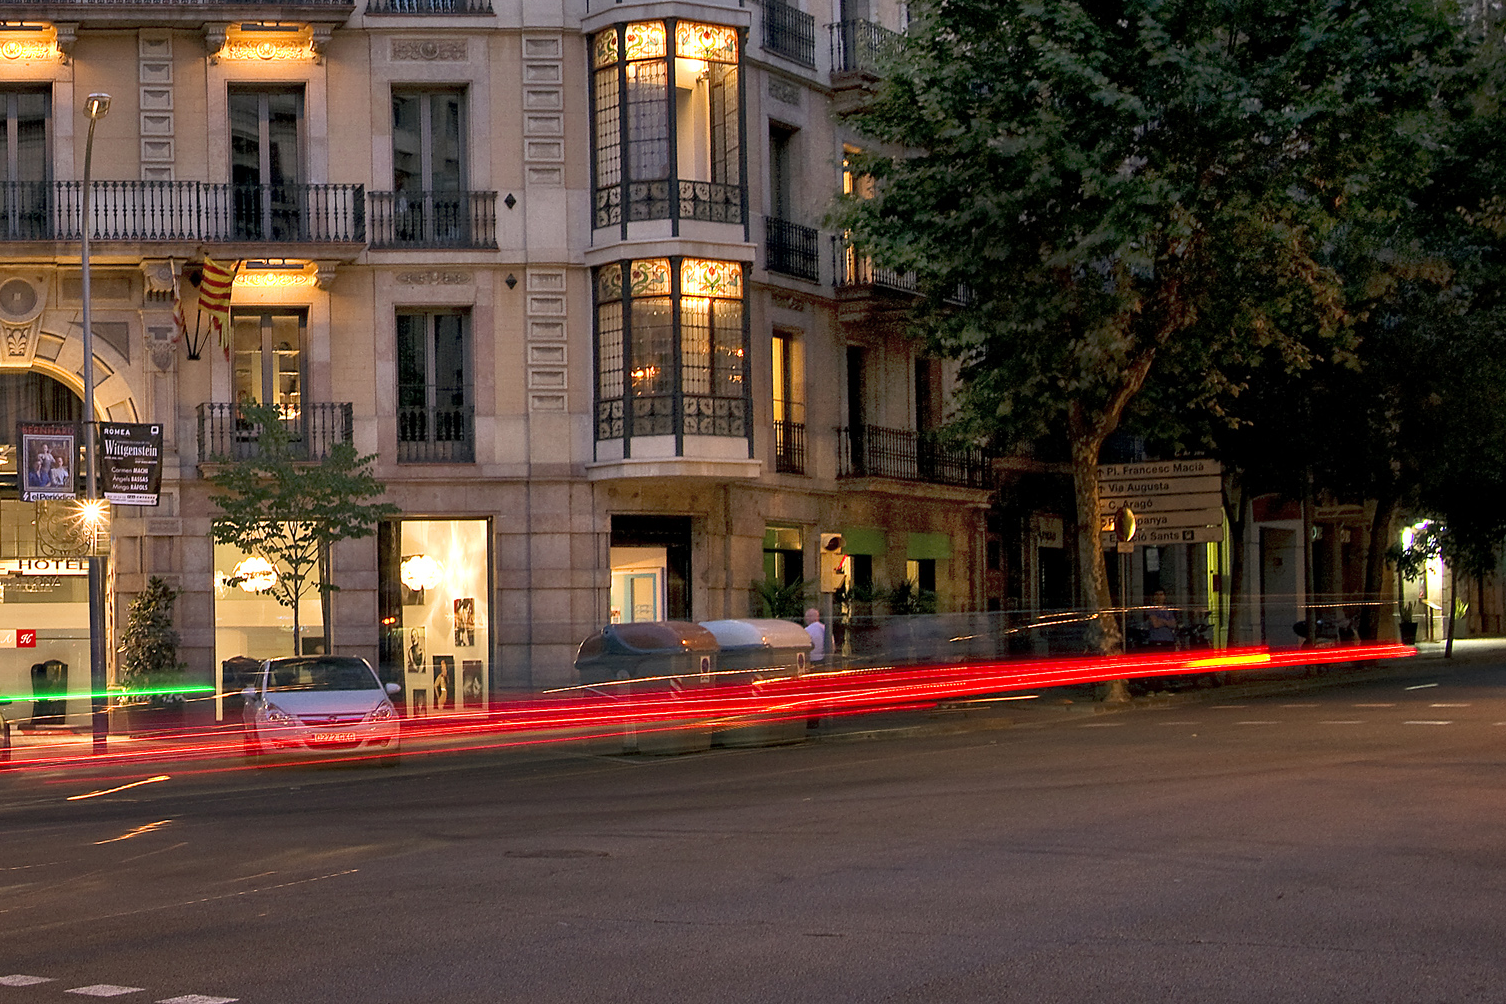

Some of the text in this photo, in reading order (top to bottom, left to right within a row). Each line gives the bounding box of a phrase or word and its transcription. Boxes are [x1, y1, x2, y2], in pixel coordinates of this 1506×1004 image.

[105, 439, 157, 457] Wittgenstein
[1123, 465, 1169, 475] Francesc
[1173, 463, 1204, 472] Macià
[1108, 482, 1169, 492] Via Augusta
[1123, 499, 1153, 509] Aragó
[1109, 532, 1179, 542] Eció Sants
[19, 559, 89, 570] HOTEL
